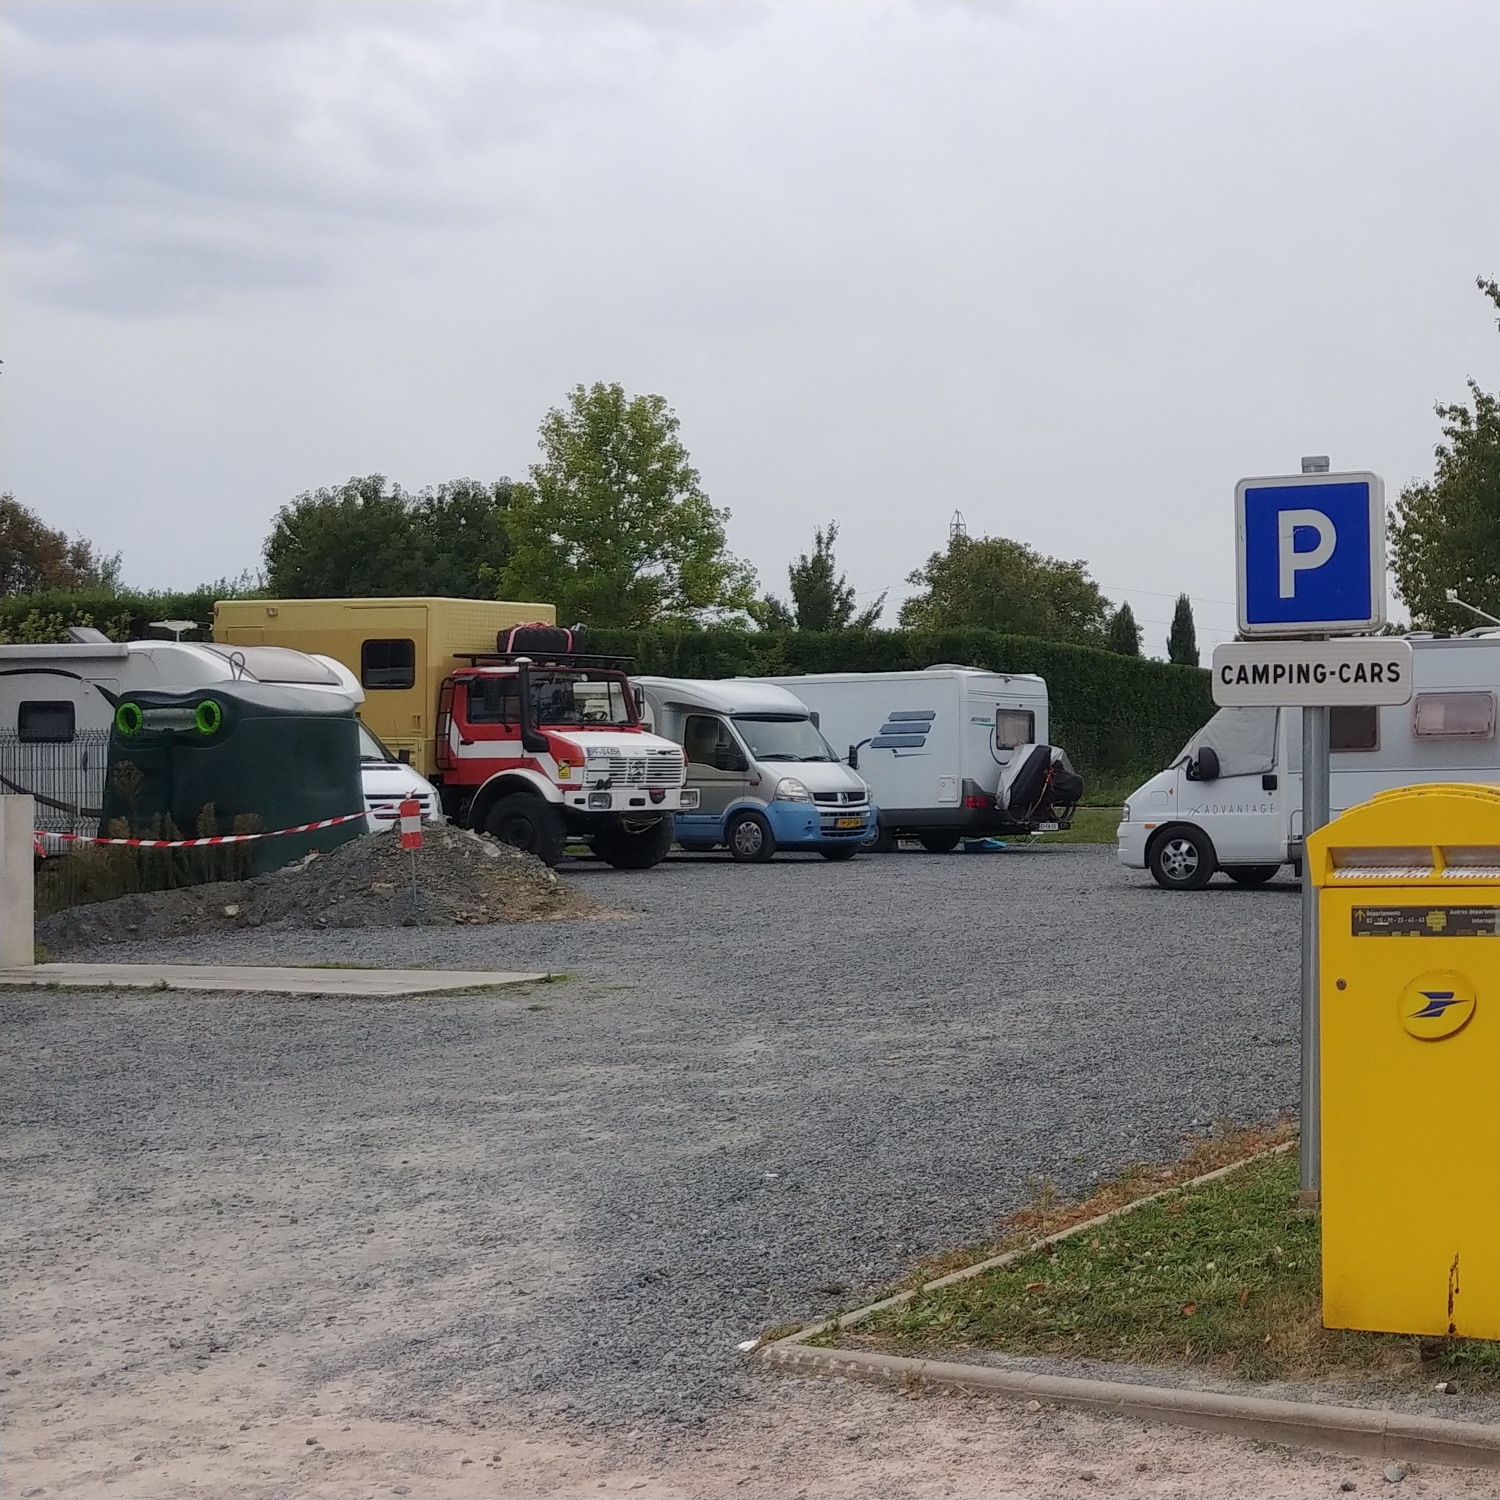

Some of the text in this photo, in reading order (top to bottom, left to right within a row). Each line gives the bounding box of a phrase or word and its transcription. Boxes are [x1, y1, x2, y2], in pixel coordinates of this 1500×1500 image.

[1277, 508, 1337, 599] P
[1221, 661, 1401, 685] CAMPING-CARS
[1204, 803, 1274, 814] ADVANTAGE
